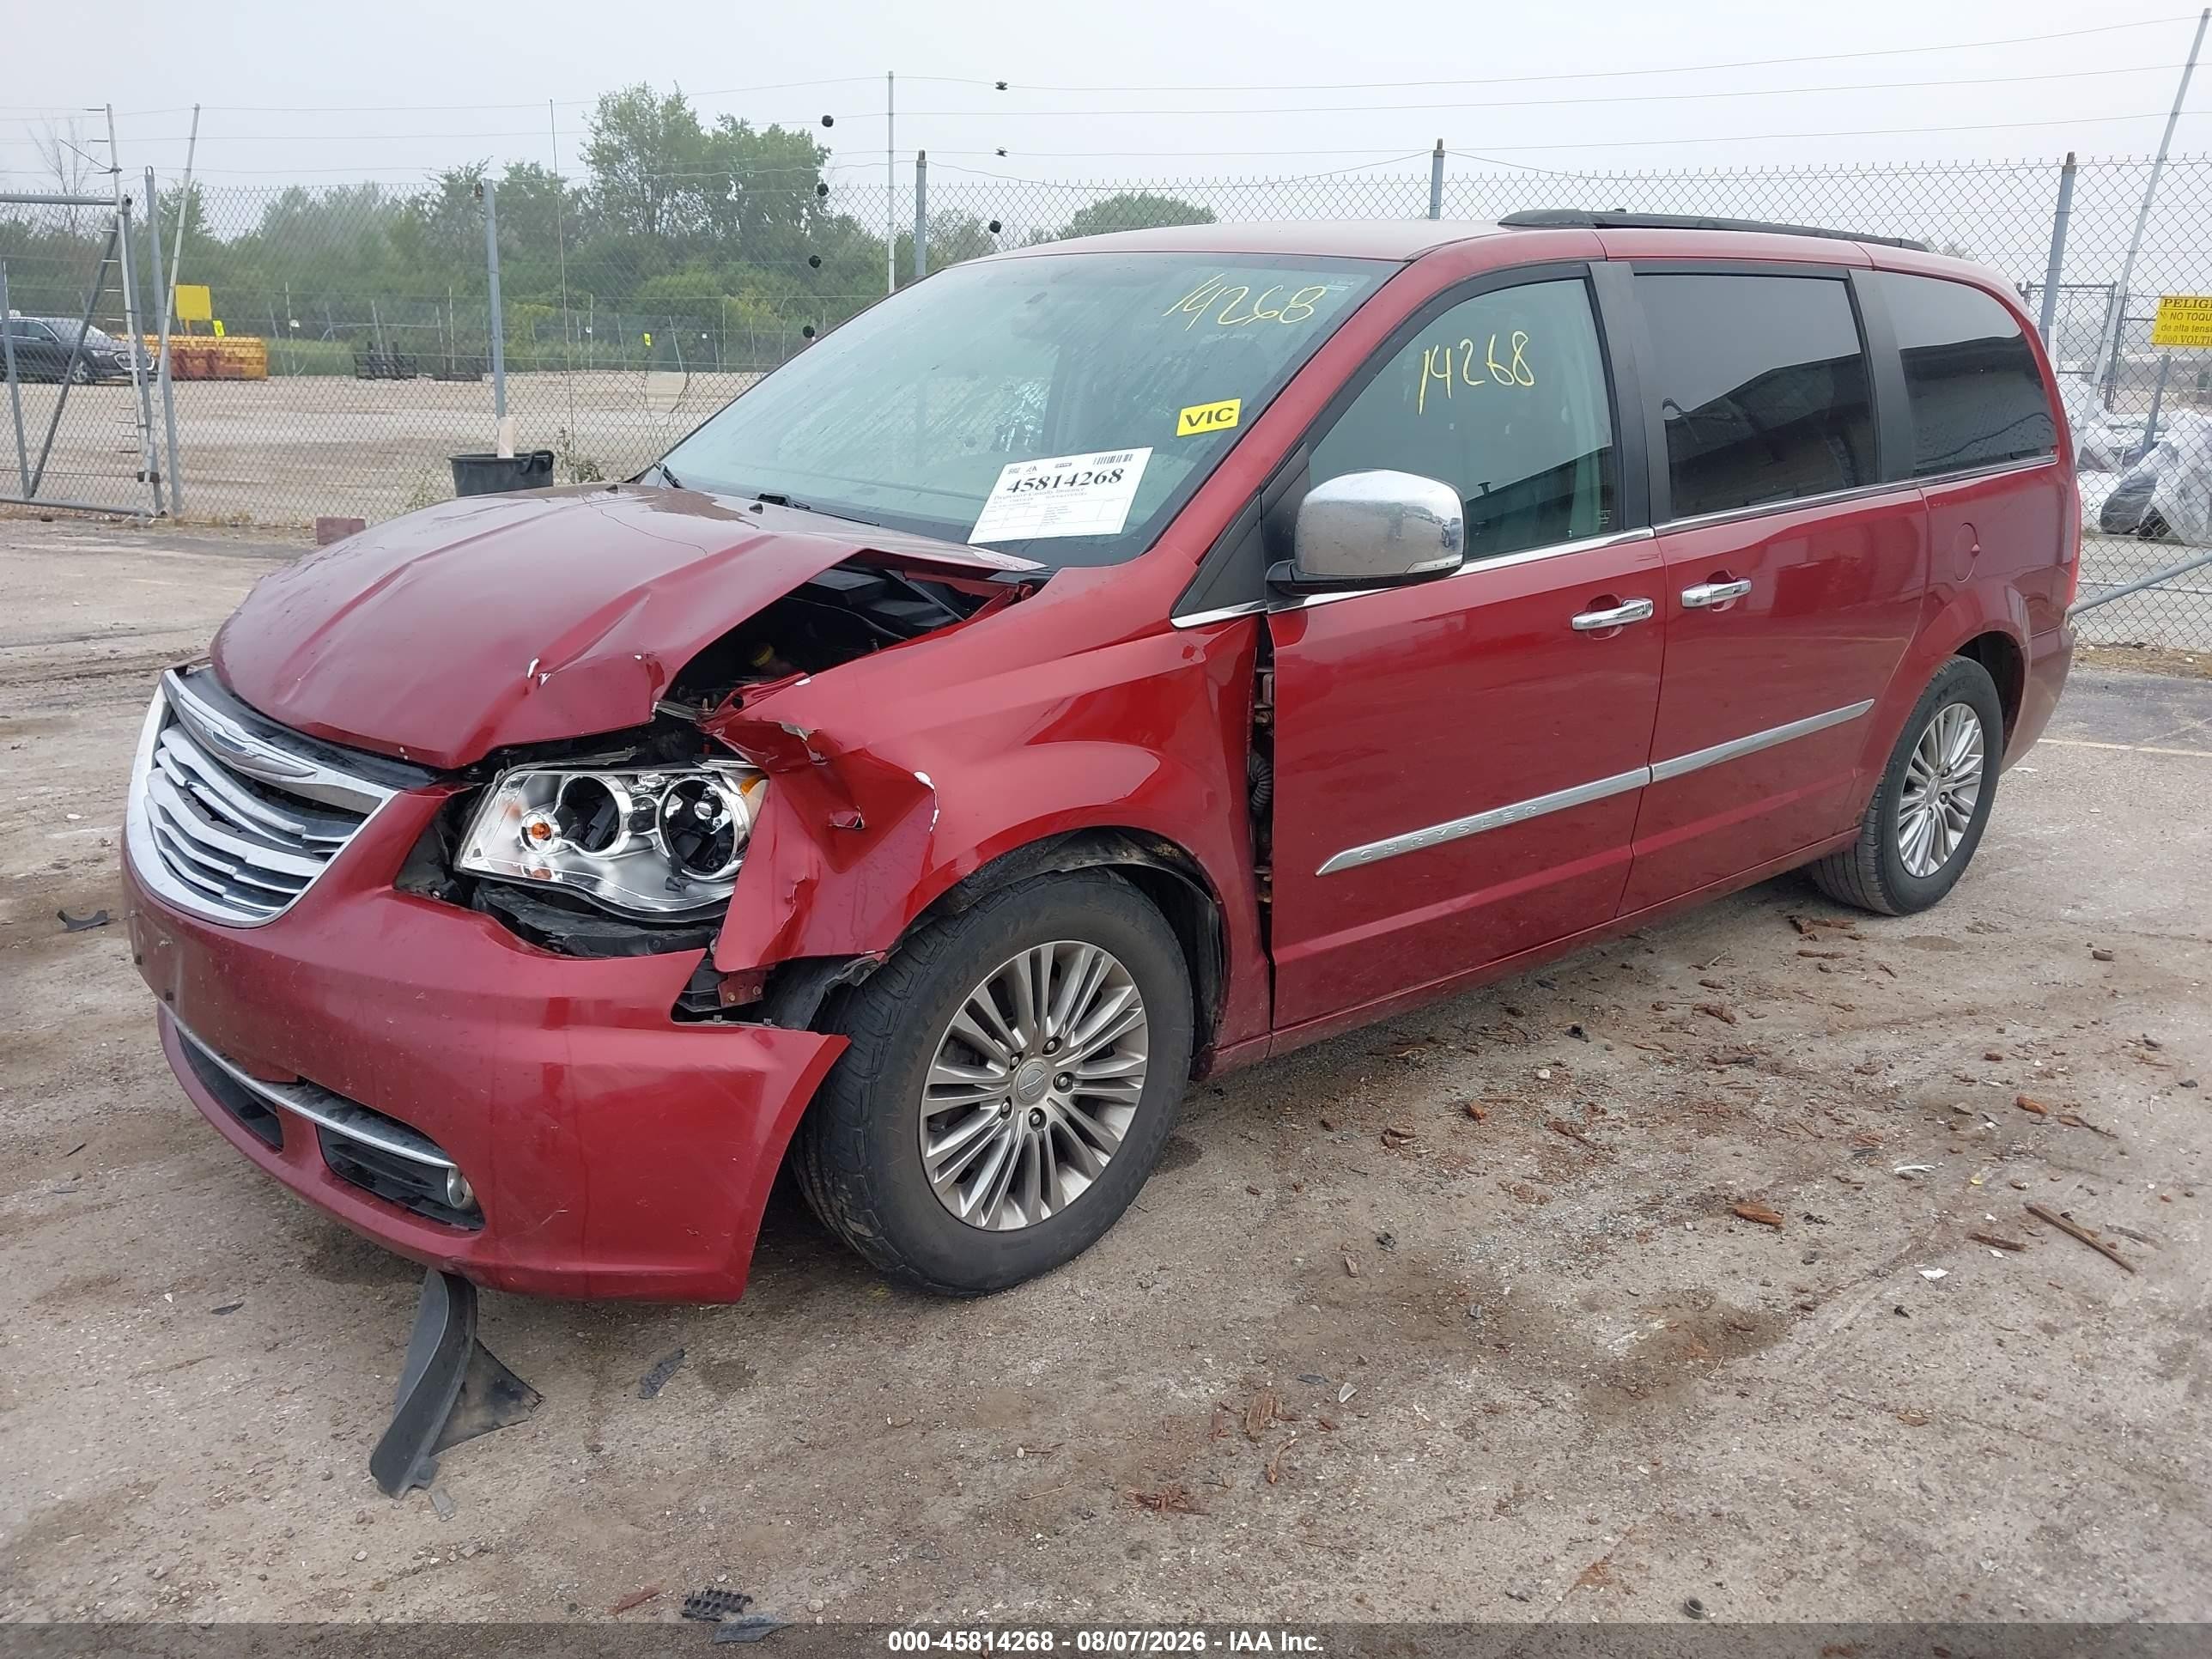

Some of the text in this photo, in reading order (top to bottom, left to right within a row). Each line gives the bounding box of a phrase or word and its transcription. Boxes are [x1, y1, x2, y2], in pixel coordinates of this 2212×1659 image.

[1162, 273, 1327, 331] 14268
[2163, 298, 2212, 308] PELIG
[2160, 323, 2172, 331] de
[2170, 312, 2184, 321] NO
[2180, 335, 2212, 344] VOLTI
[1419, 330, 1535, 416] 14268
[1185, 407, 1234, 428] VIC
[1006, 468, 1125, 493] 45814268
[1360, 804, 1538, 861] CHRYSLER
